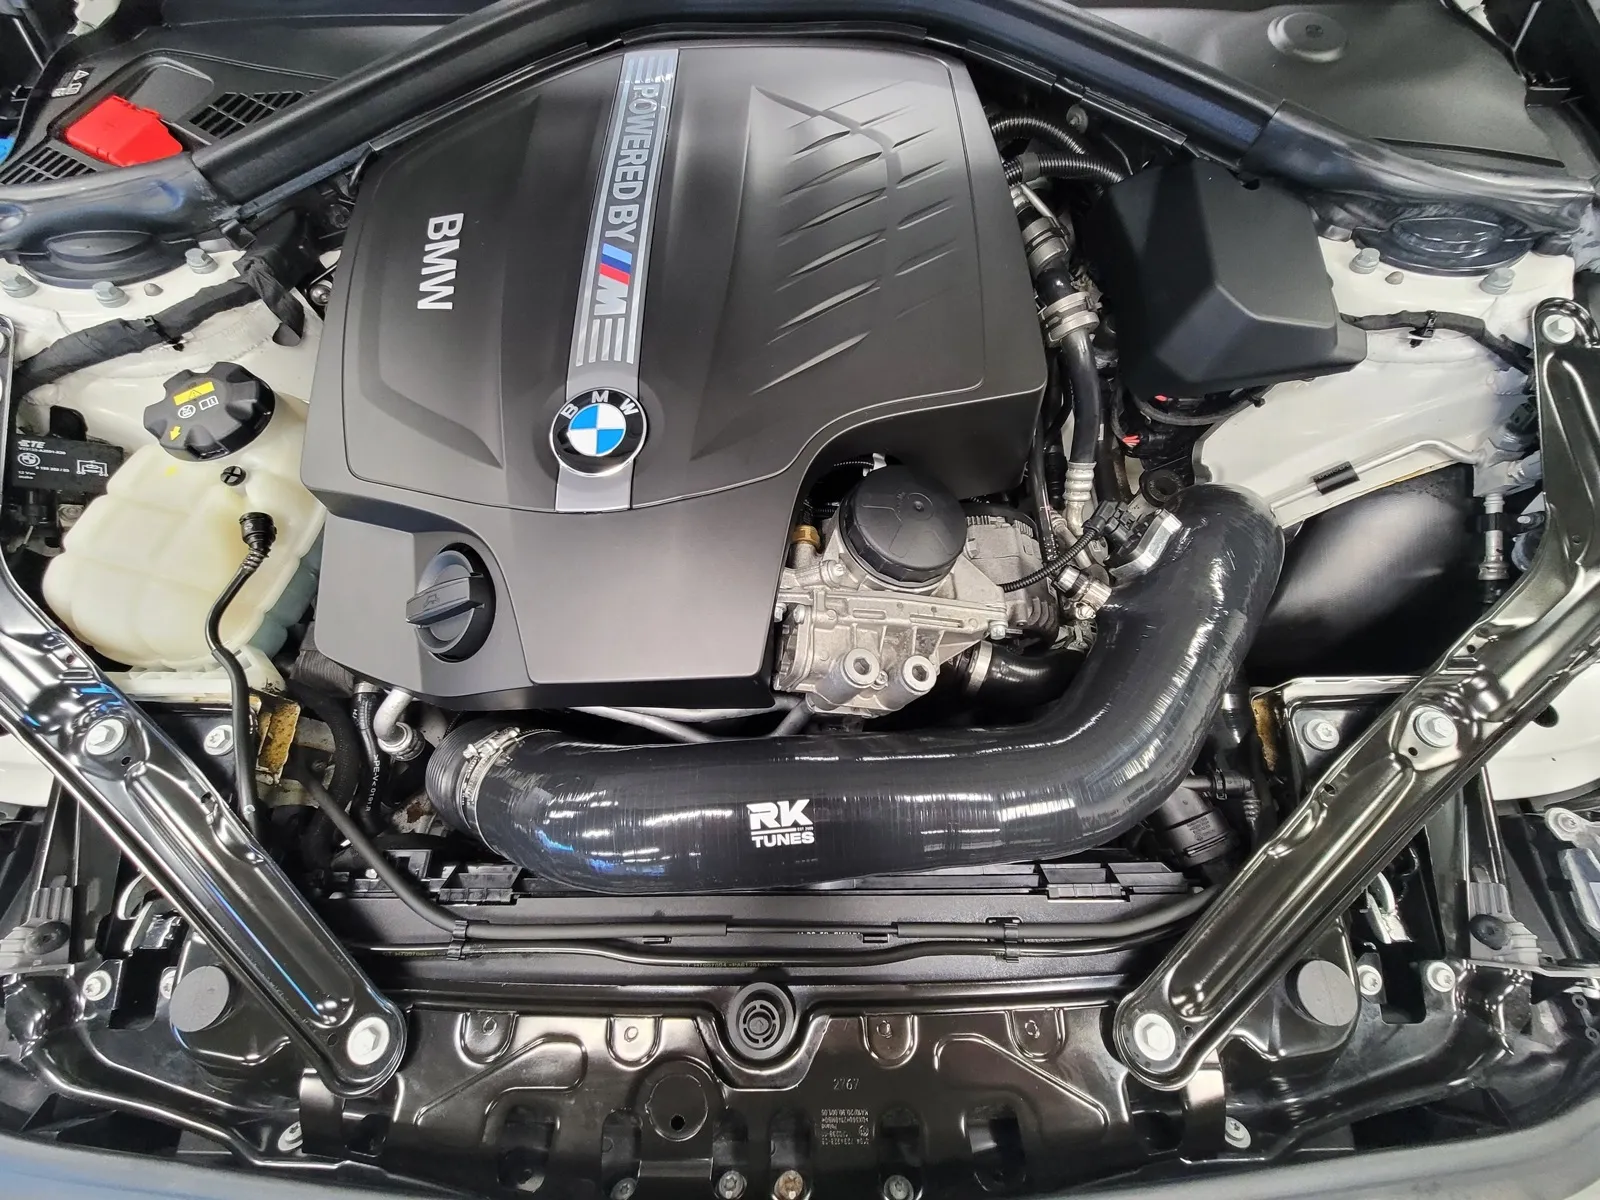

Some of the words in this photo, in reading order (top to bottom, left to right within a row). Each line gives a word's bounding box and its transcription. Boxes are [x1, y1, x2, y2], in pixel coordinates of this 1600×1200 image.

[612, 84, 659, 200] POWERED
[605, 204, 639, 243] BY
[417, 212, 465, 310] BMW
[593, 273, 630, 316] M
[560, 390, 640, 419] BMW
[746, 799, 814, 830] RK
[751, 831, 815, 848] TUNES
